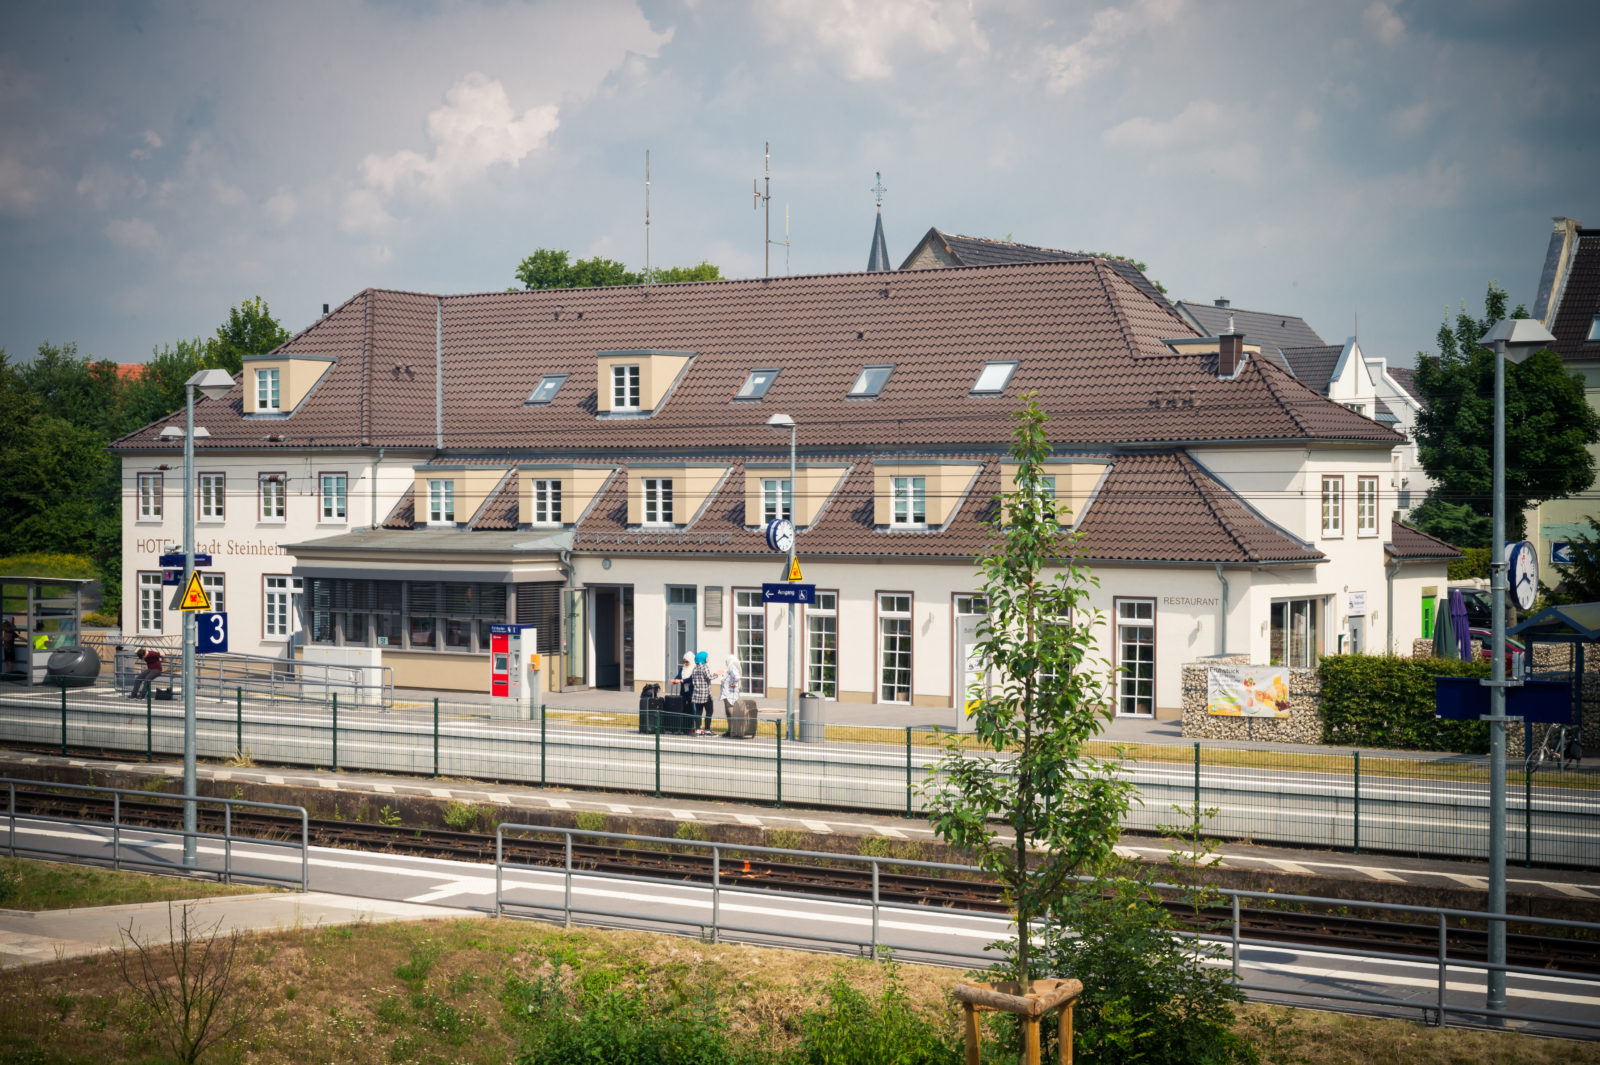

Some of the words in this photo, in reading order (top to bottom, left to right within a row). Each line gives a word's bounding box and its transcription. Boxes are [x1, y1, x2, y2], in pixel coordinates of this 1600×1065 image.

[196, 539, 221, 554] tadt
[1163, 596, 1219, 606] RESTAURANT
[209, 614, 225, 644] 3
